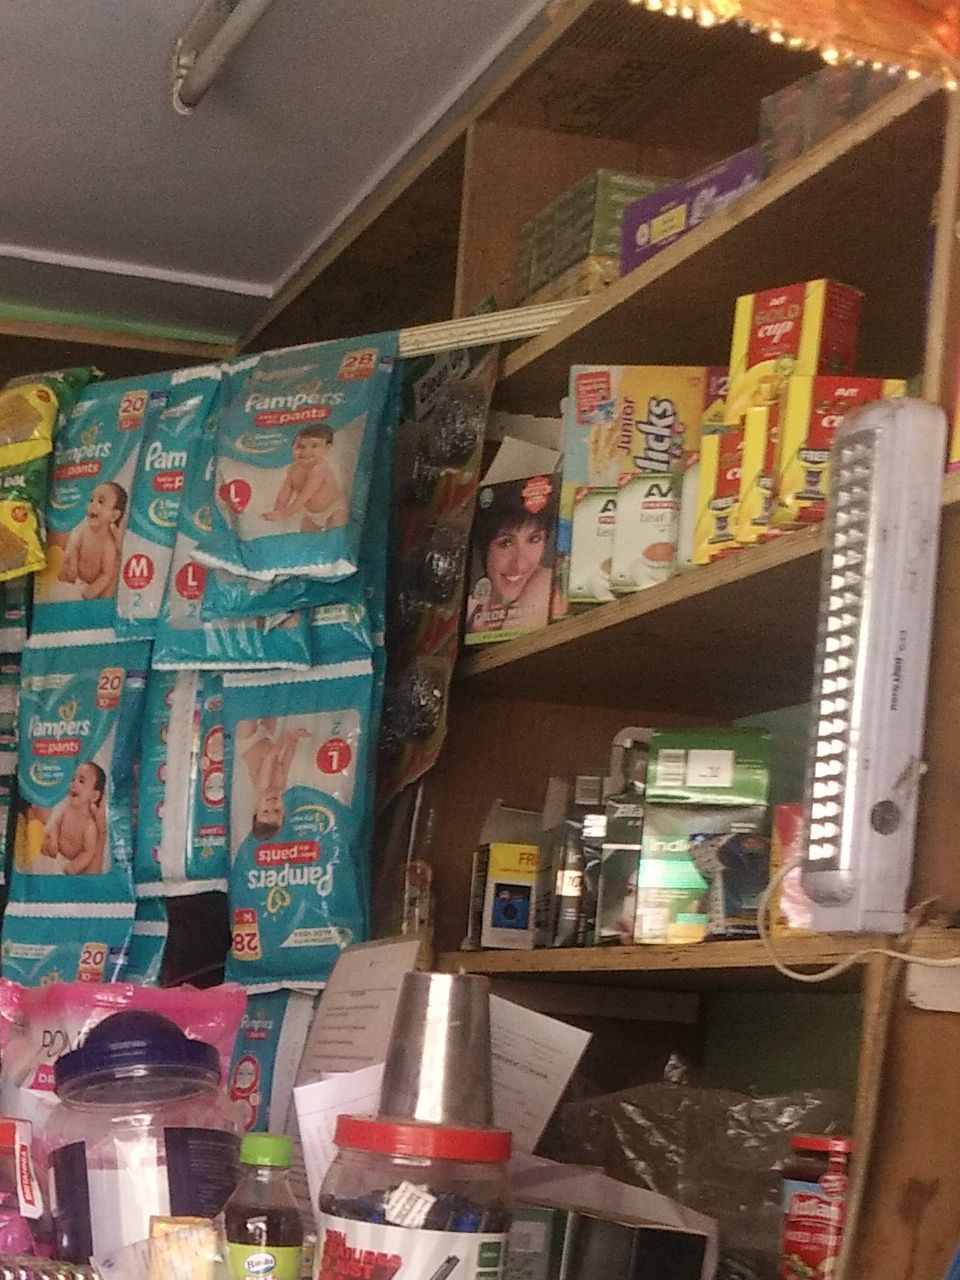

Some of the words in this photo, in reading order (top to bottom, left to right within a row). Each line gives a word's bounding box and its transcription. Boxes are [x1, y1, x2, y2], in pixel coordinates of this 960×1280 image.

[344, 352, 375, 369] 28
[121, 397, 145, 413] 20
[244, 391, 346, 413] Pampers
[279, 407, 327, 425] pants
[228, 483, 241, 504] L
[600, 499, 617, 514] A
[127, 555, 149, 580] M
[187, 566, 198, 587] L
[99, 675, 121, 691] 20
[27, 714, 92, 741] Pampers
[257, 845, 298, 863] pants
[247, 865, 334, 897] Pampers
[232, 931, 259, 953] 28
[80, 950, 106, 966] 20
